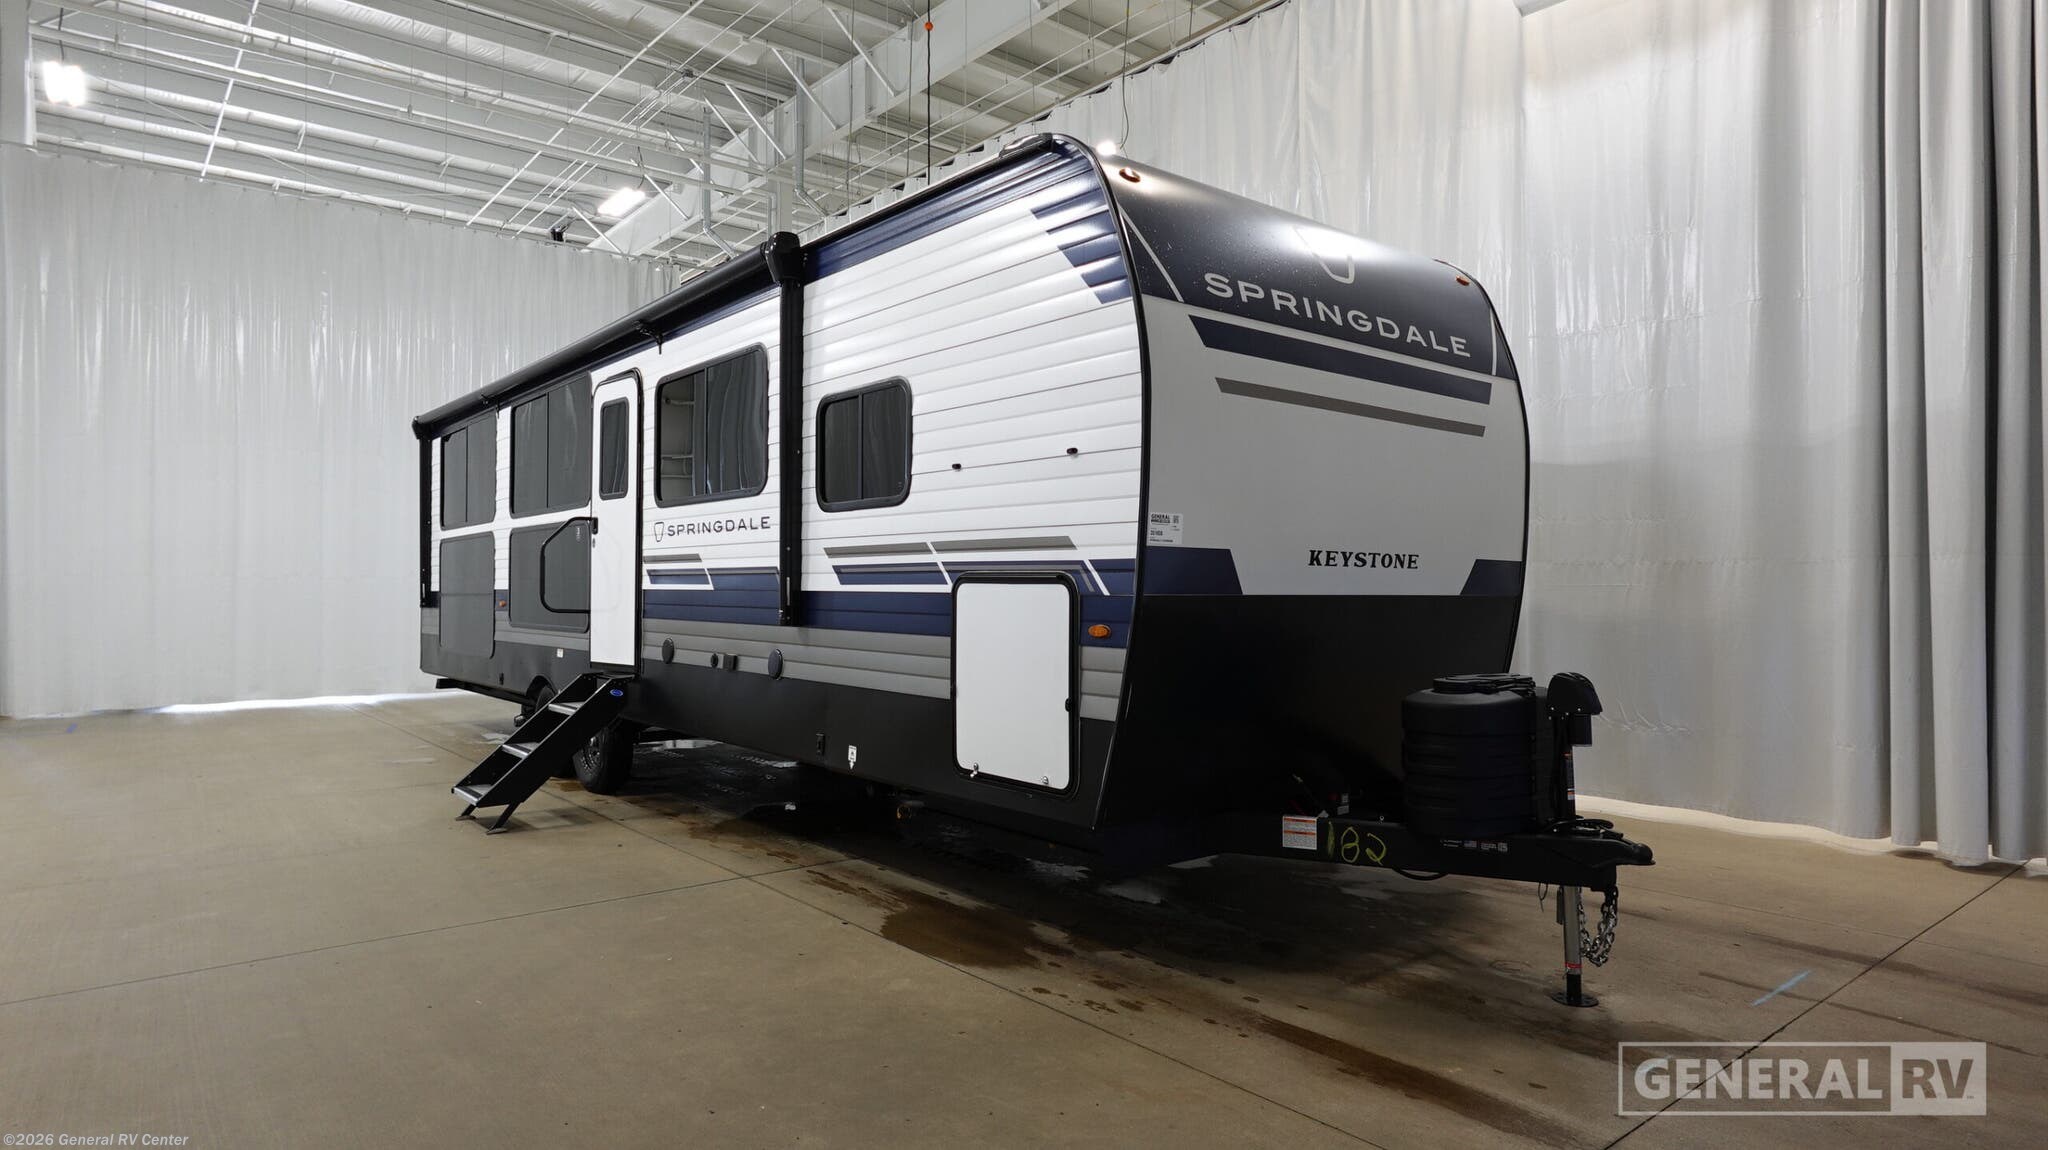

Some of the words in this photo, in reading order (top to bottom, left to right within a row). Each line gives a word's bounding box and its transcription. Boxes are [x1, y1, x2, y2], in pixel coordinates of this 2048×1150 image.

[1204, 272, 1472, 359] SPRINGDALE
[667, 516, 771, 537] SPRINGDALE
[1308, 549, 1420, 570] KEYSTONE
[1327, 820, 1387, 866] 182
